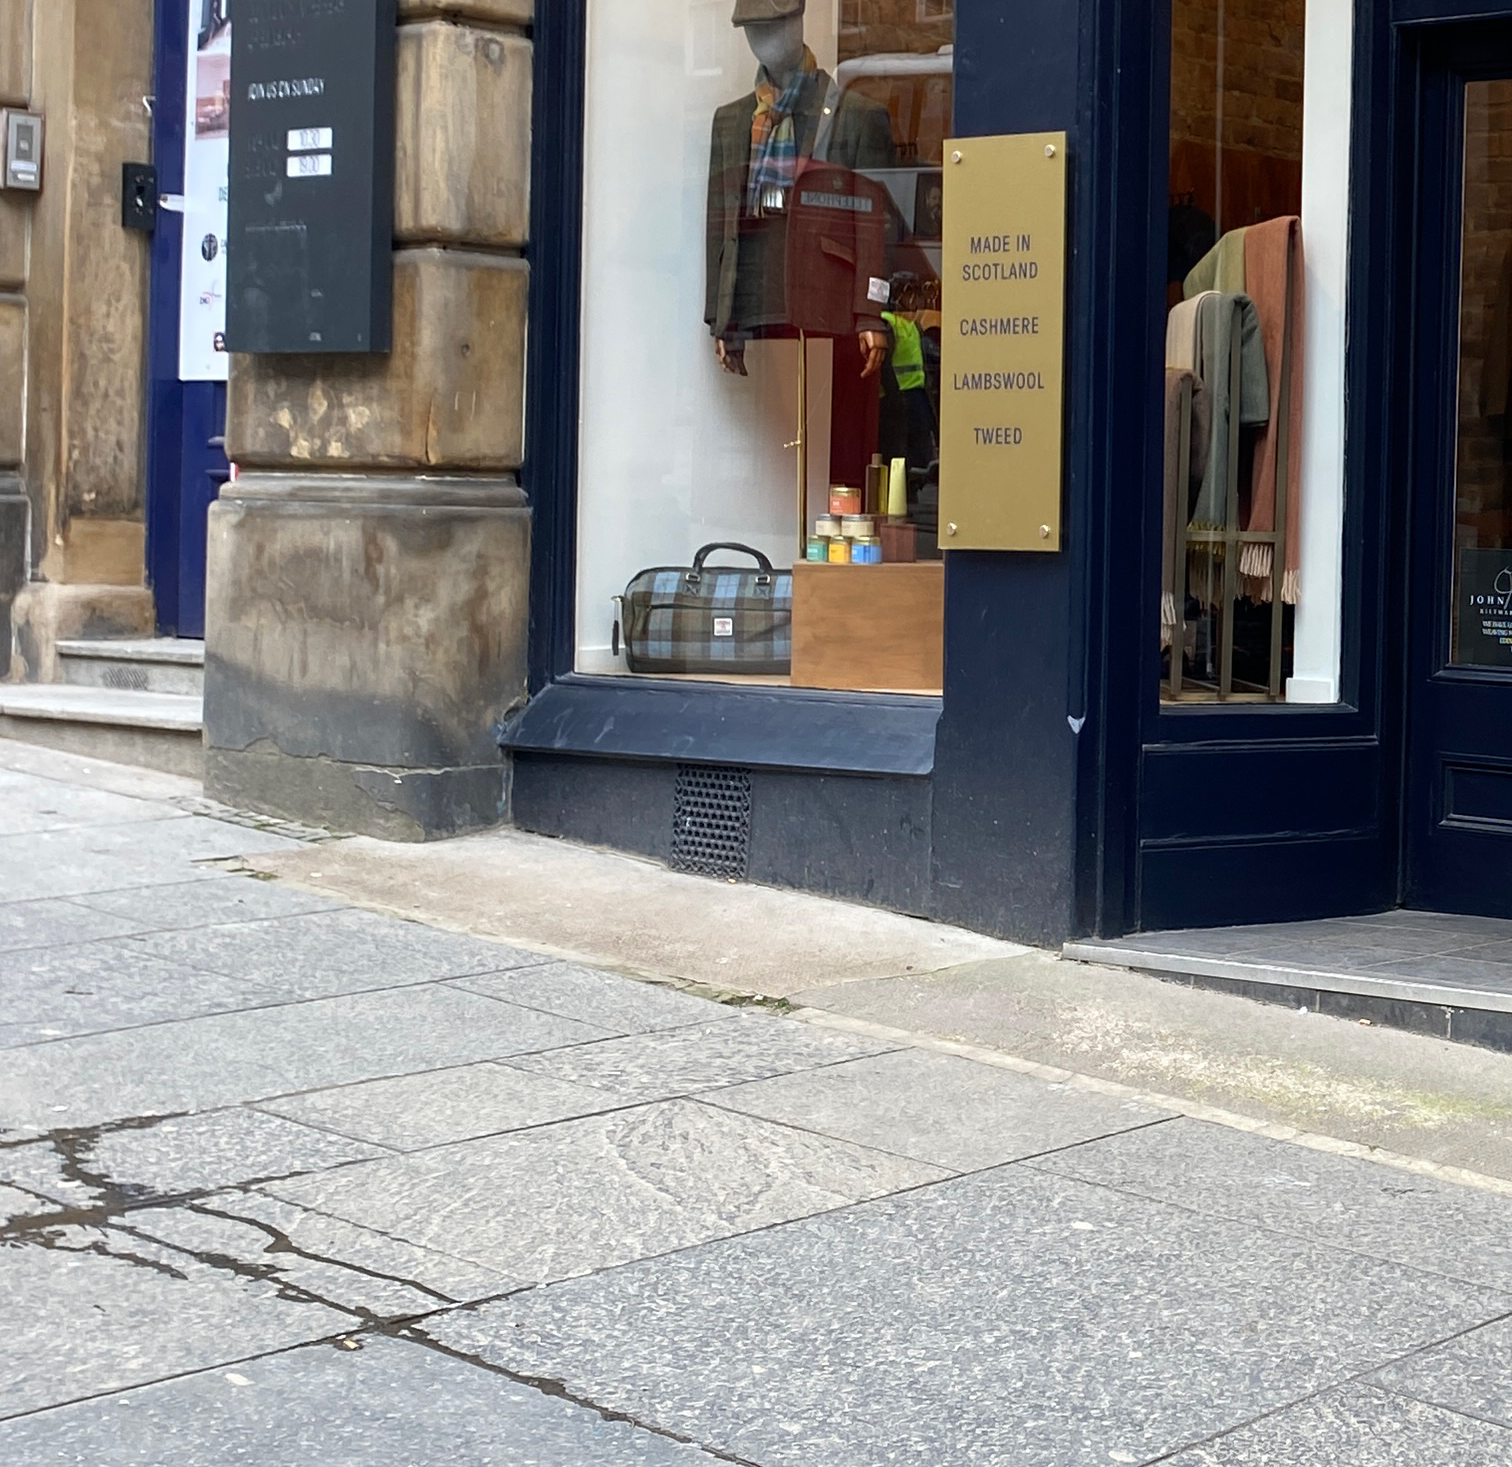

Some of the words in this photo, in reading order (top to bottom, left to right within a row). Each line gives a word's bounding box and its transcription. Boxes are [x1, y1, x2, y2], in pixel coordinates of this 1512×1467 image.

[970, 235, 1011, 254] MADE
[1016, 233, 1031, 252] IN
[962, 261, 1039, 282] SCOTLAND
[960, 316, 1039, 336] CASHMERE
[953, 372, 1045, 391] LAMBSWOOL
[973, 427, 1022, 445] TWEED
[1469, 595, 1505, 606] JOHN
